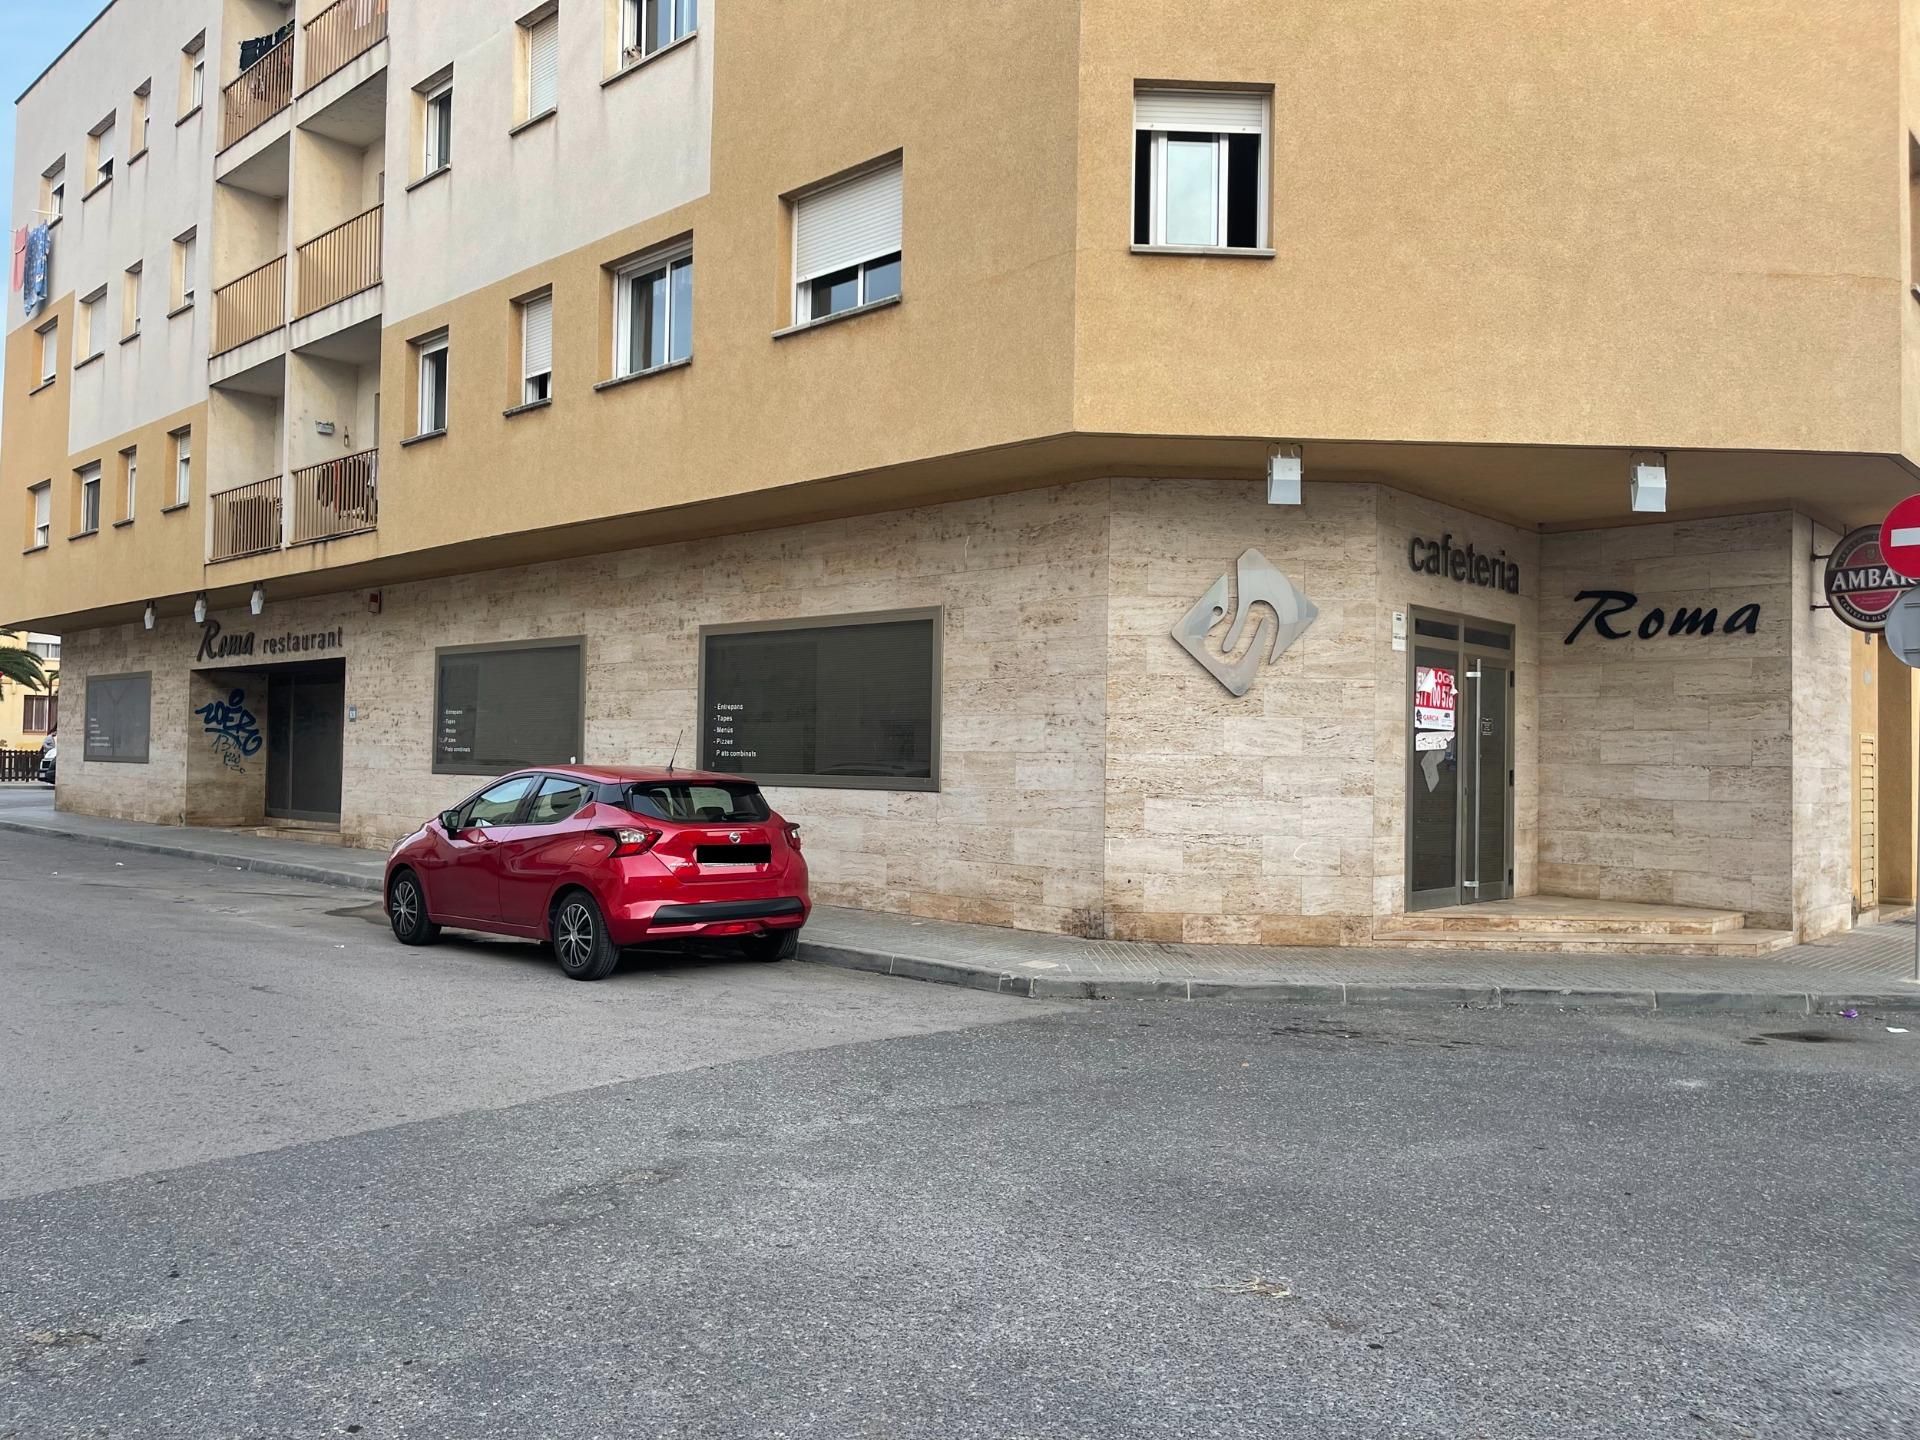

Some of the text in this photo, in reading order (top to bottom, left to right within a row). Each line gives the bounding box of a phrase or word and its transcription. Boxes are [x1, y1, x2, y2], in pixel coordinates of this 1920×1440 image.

[1408, 533, 1519, 595] cafeteria
[196, 619, 343, 662] Roma restaurant
[1564, 590, 1760, 645] Roma
